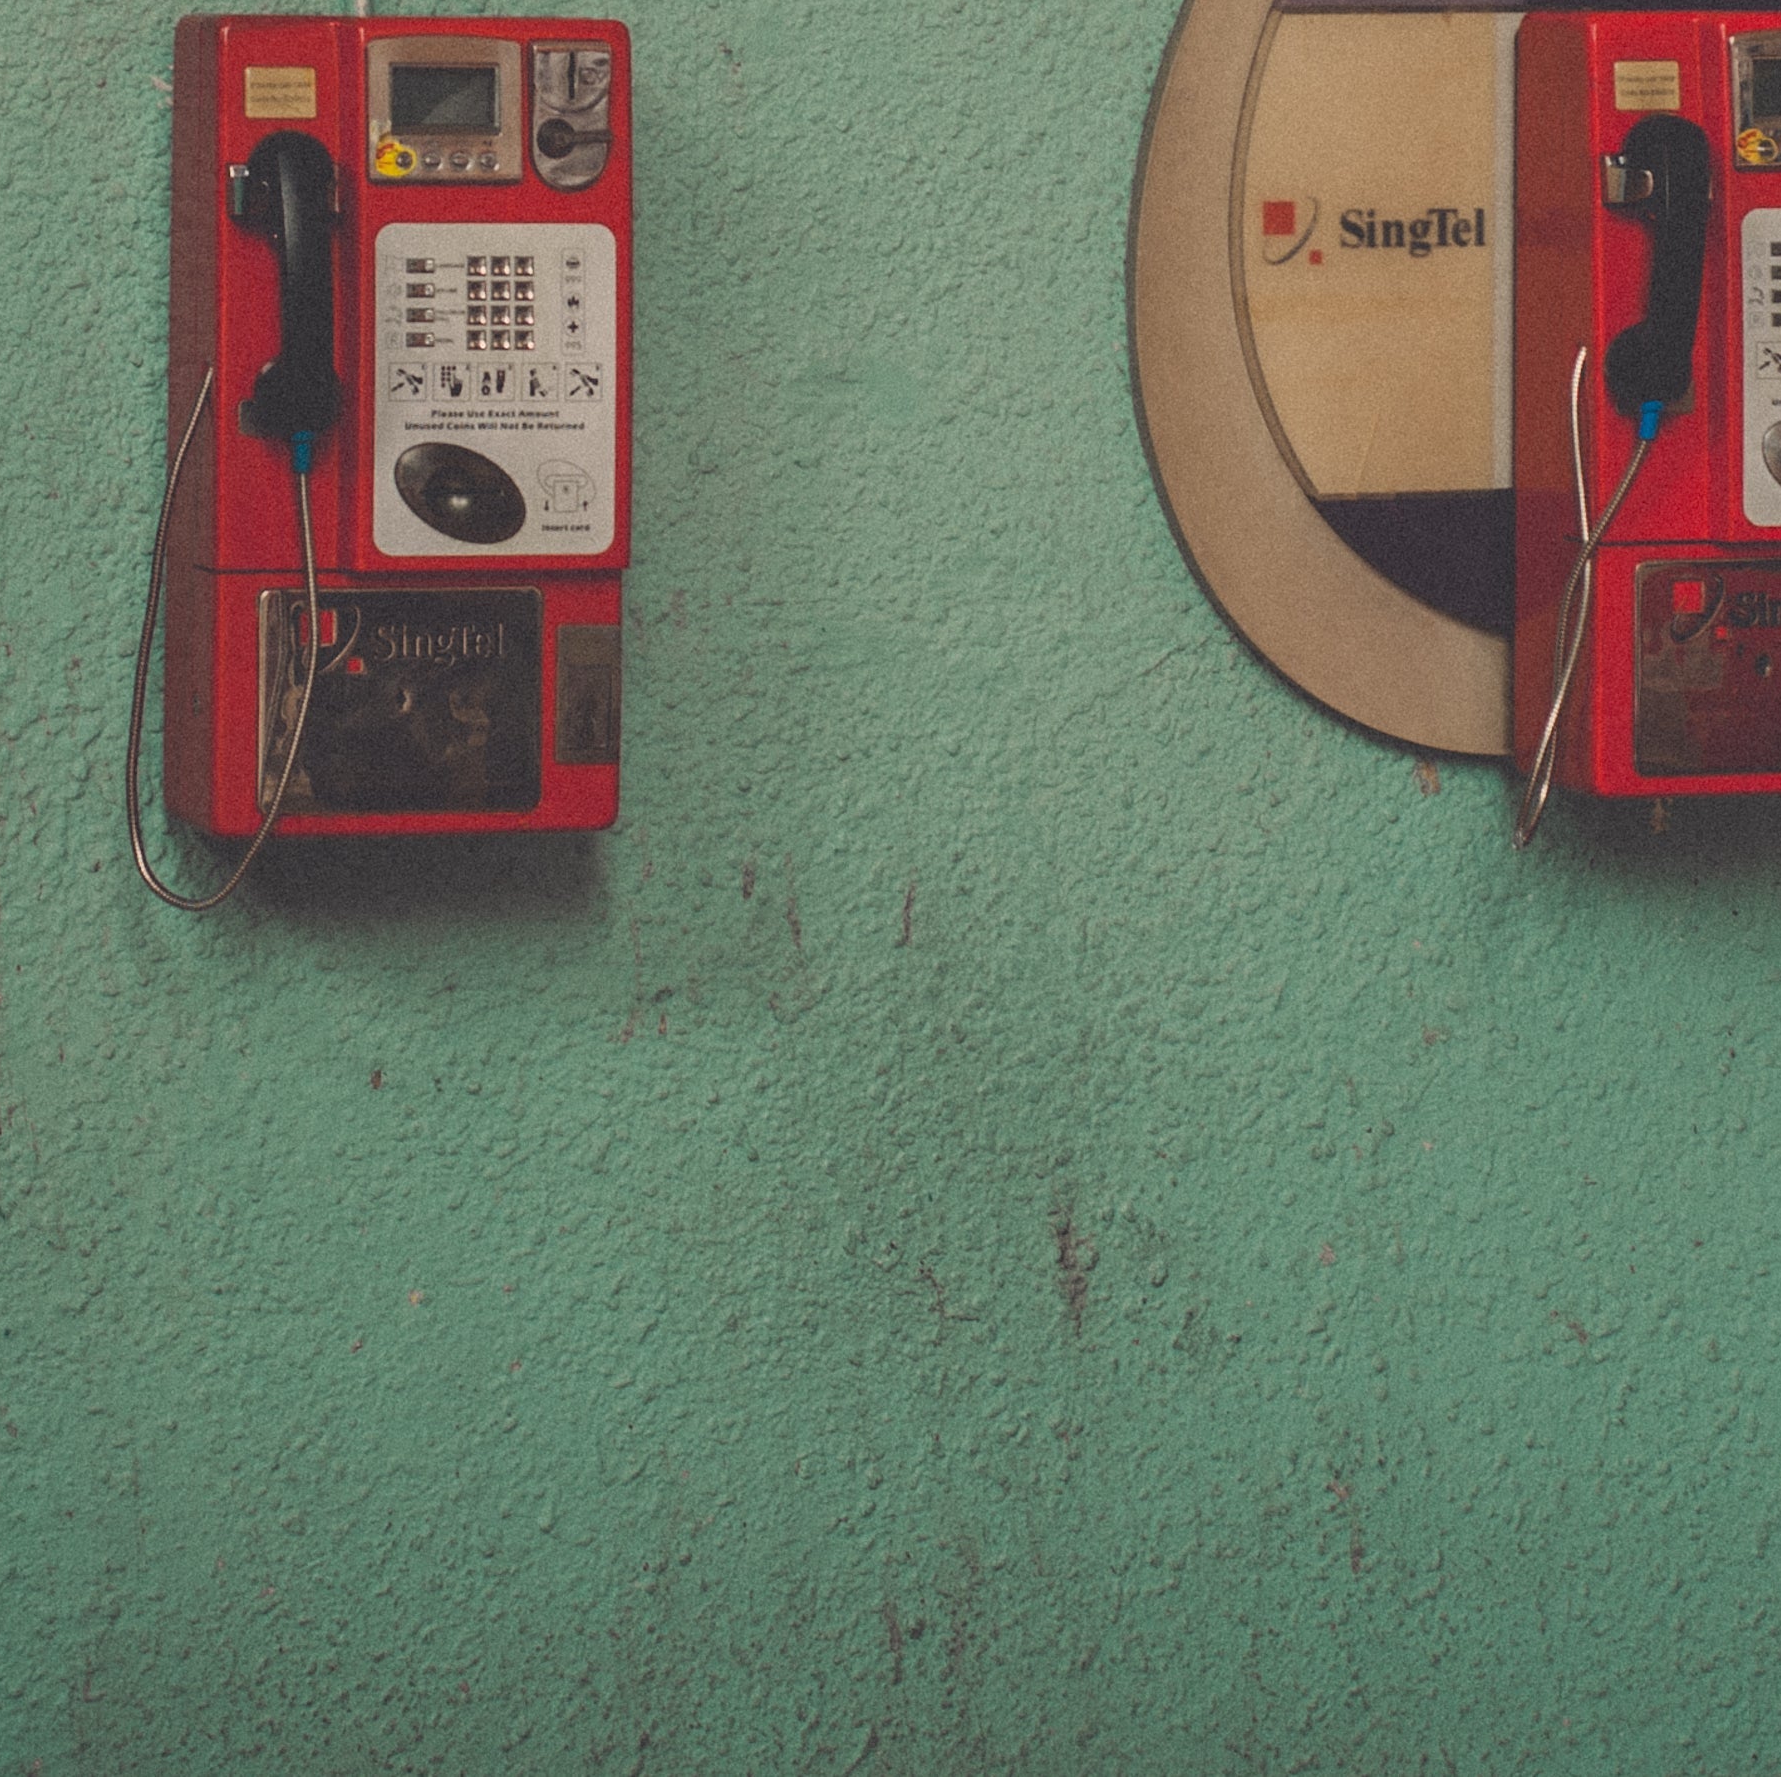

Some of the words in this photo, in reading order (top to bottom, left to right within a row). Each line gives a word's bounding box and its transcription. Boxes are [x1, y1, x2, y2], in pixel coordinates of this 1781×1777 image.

[1339, 208, 1486, 258] SingTel
[404, 422, 444, 431] Unused
[446, 422, 475, 431] Coins
[477, 422, 498, 431] Will
[500, 422, 519, 430] Not
[521, 422, 534, 430] Be
[536, 422, 585, 430] Returned
[431, 409, 464, 418] Please
[467, 409, 485, 418] Use
[488, 409, 516, 418] Exact
[518, 409, 559, 418] Amount
[373, 622, 505, 667] SingTel
